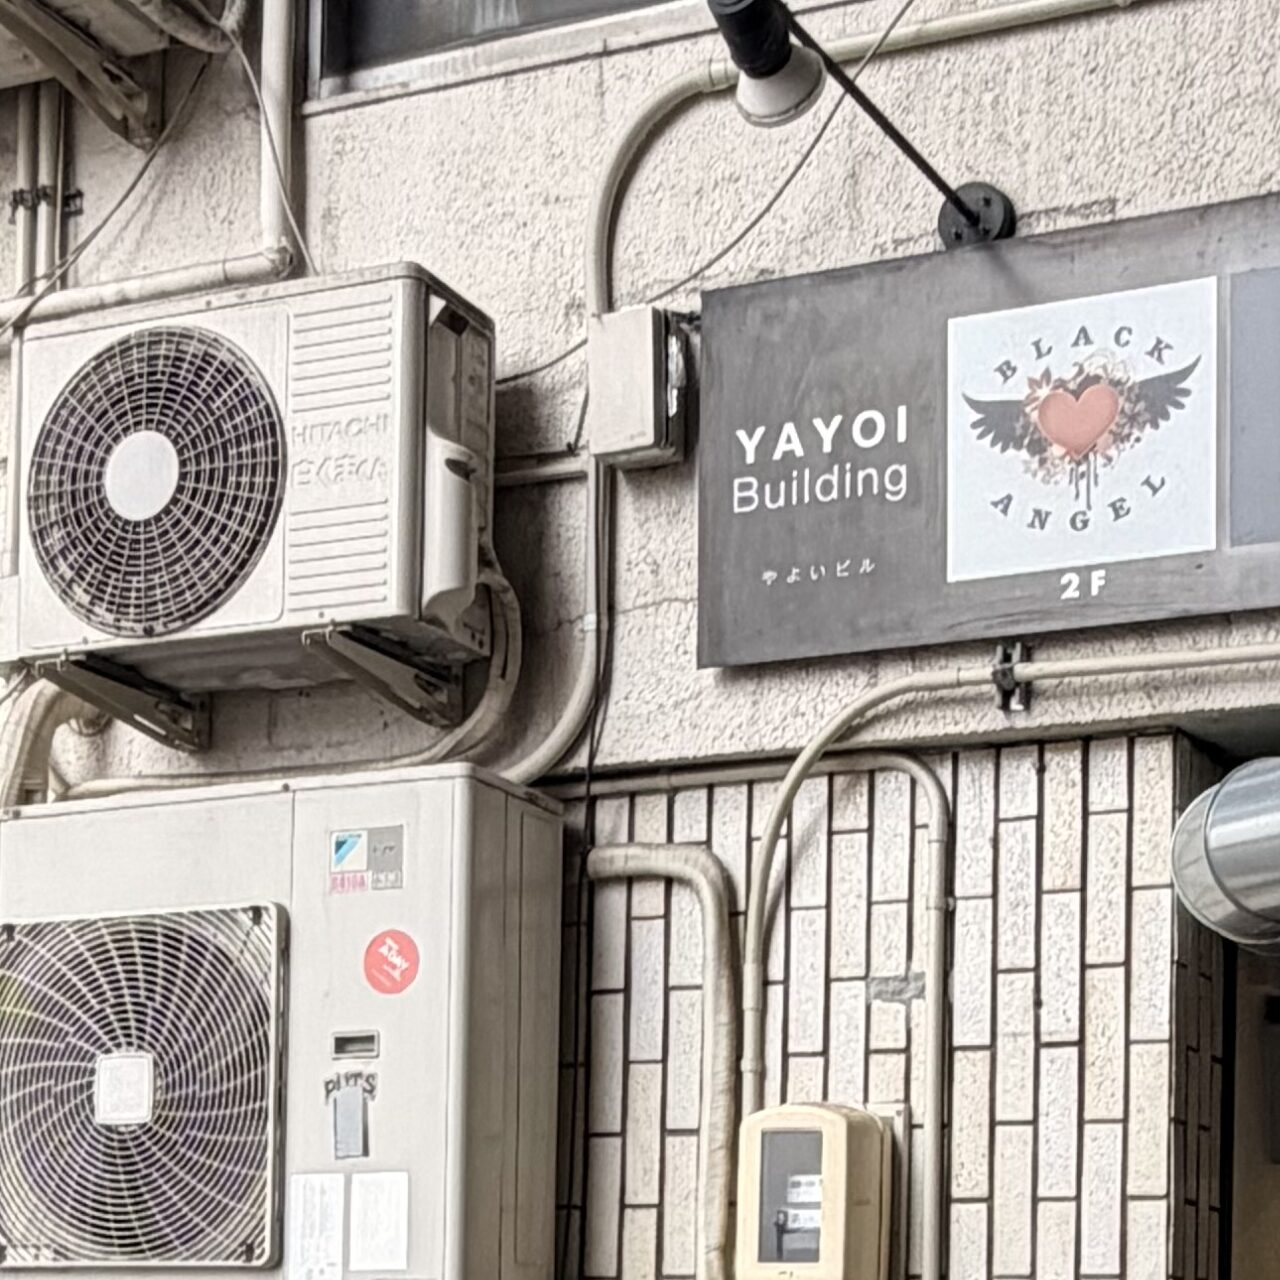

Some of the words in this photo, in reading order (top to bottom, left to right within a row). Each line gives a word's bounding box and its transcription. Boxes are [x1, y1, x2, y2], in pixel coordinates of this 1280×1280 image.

[995, 326, 1174, 383] BLACK
[291, 414, 388, 447] HITACHI
[736, 405, 908, 464] YAYOI
[733, 463, 908, 514] Building
[991, 474, 1167, 532] ANGEL
[761, 558, 876, 586] やよいビル
[1060, 570, 1107, 600] 2F
